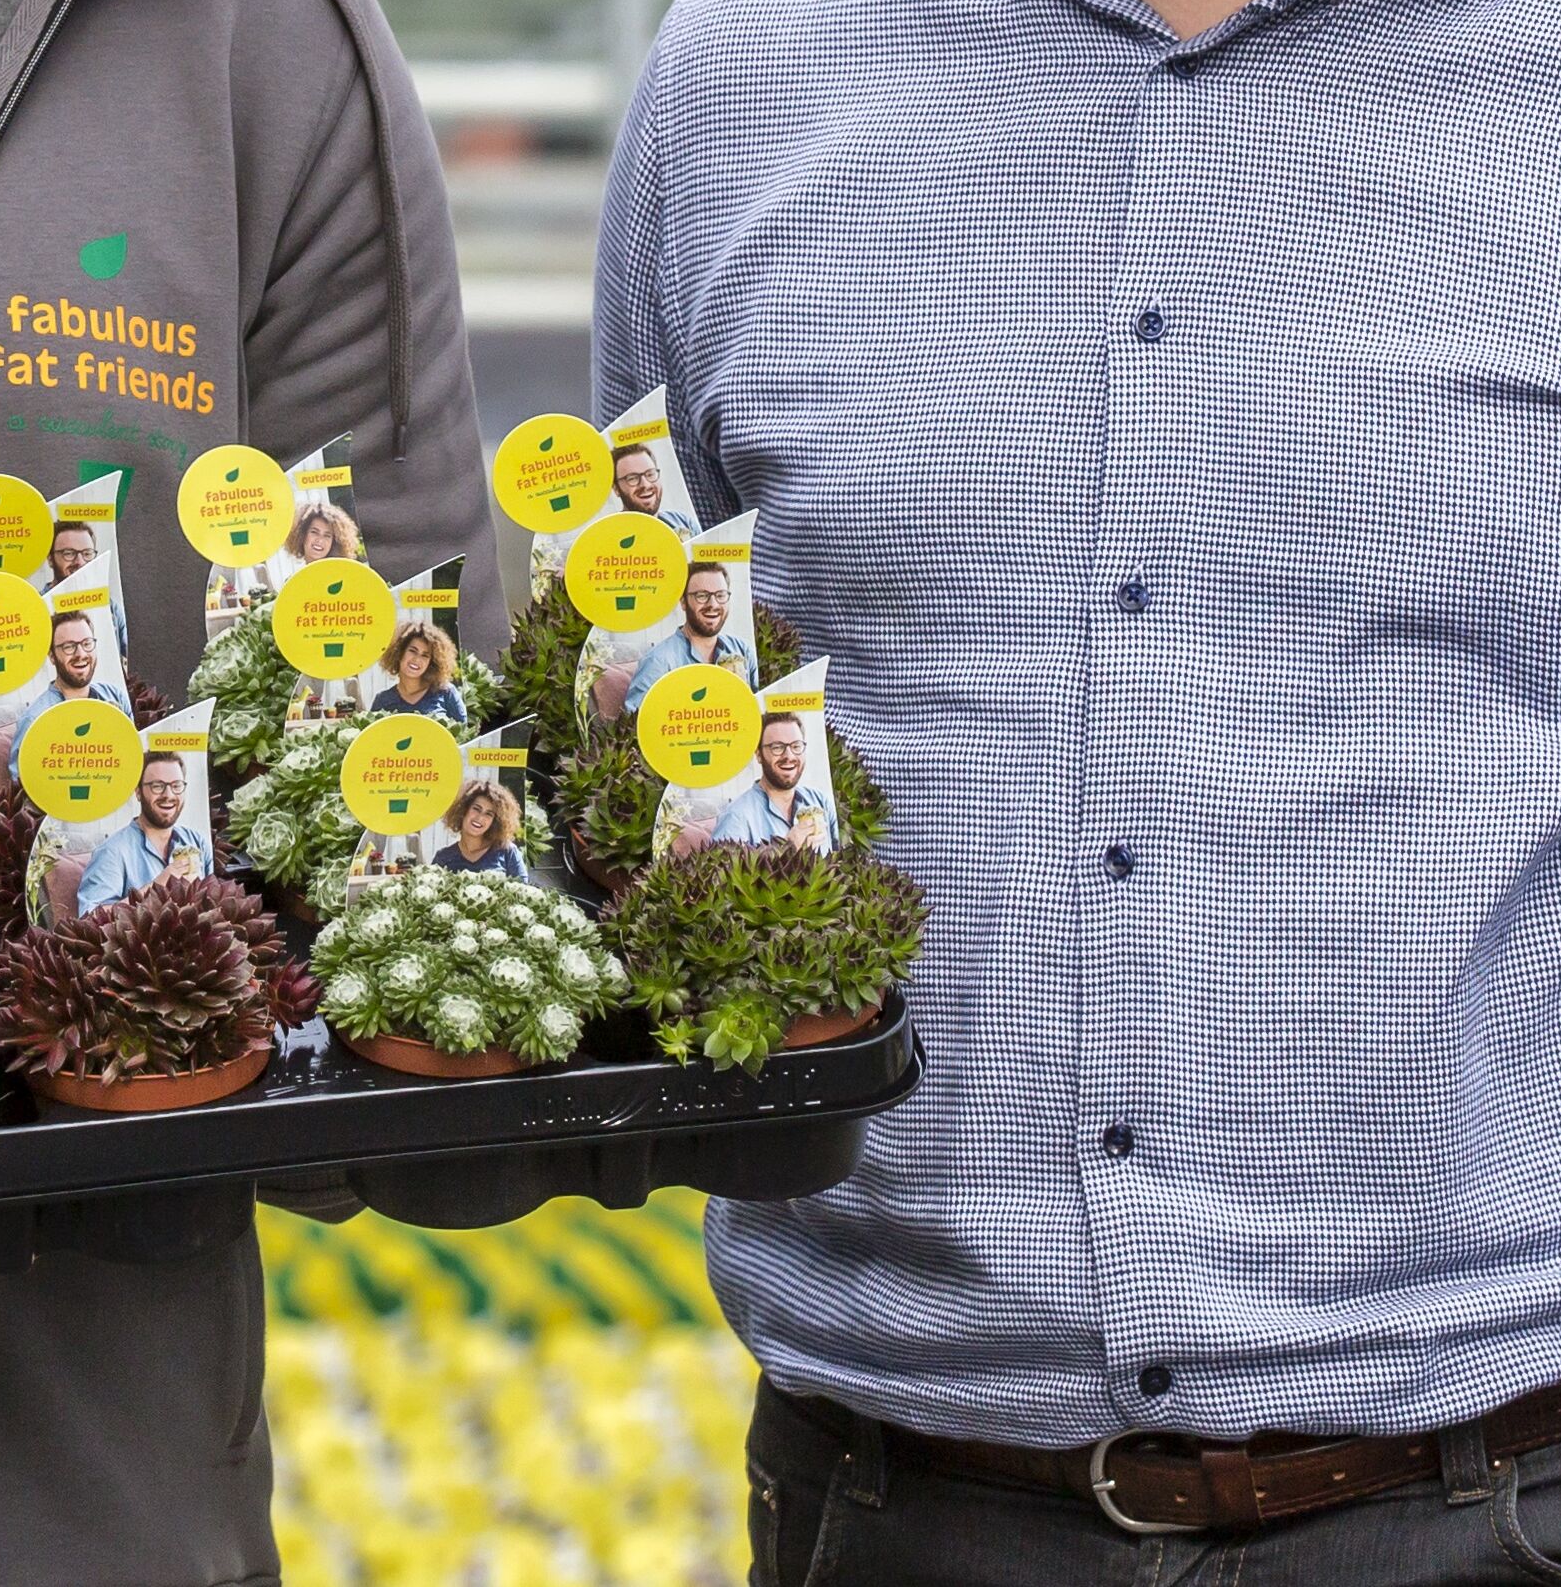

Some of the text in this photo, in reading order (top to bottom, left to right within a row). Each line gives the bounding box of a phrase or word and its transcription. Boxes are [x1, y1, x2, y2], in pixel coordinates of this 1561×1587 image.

[7, 294, 196, 356] fabulous
[75, 352, 215, 413] friends
[618, 425, 661, 441] outdoor
[521, 451, 580, 475] fabulous
[302, 473, 343, 484] outdoor
[517, 463, 591, 490] fat friends
[206, 488, 263, 502] fabulous
[64, 507, 108, 516] outdoor
[200, 500, 272, 517] fat friends
[700, 548, 743, 557] outdoor
[596, 555, 657, 566] fabulous
[589, 568, 664, 580] fat friends
[60, 593, 103, 607] outdoor
[407, 594, 452, 603] outdoor
[304, 602, 365, 612] fabulous
[296, 615, 373, 627] fat friends
[772, 698, 817, 707] outdoor
[668, 708, 730, 721] fabulous
[661, 721, 738, 735] fat friends
[155, 738, 200, 746] outdoor
[50, 743, 112, 753] fabulous
[42, 757, 120, 768] fat friends
[372, 757, 432, 768] fabulous
[474, 753, 519, 761] outdoor
[363, 771, 439, 782] fat friends
